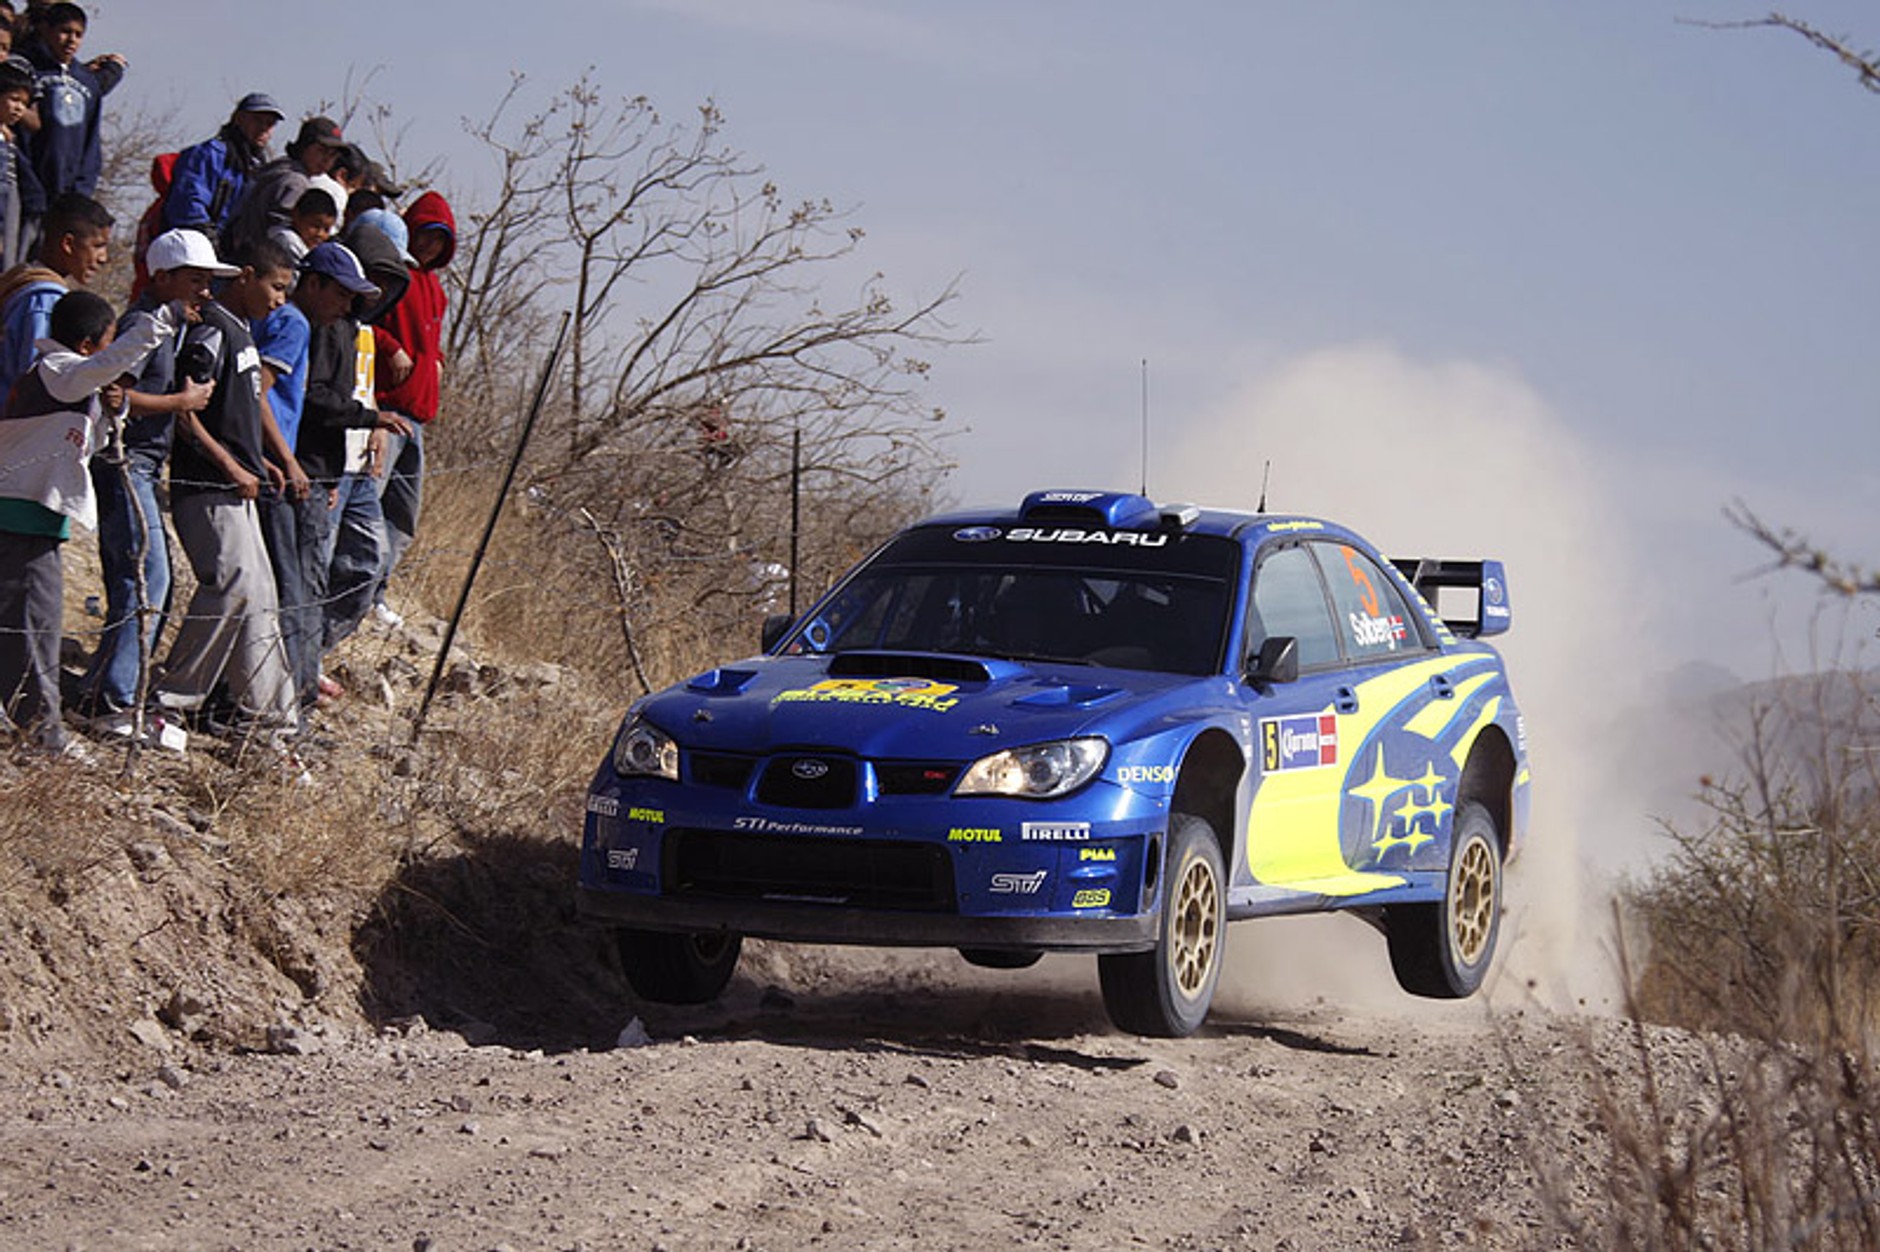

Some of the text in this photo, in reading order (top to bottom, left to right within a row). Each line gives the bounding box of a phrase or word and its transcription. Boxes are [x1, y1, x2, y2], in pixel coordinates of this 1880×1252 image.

[1005, 528, 1168, 547] SUBARU
[1340, 546, 1380, 617] 5
[1266, 723, 1278, 770] 5
[1117, 766, 1175, 783] DENSO
[628, 807, 665, 823] MOTUL
[766, 822, 864, 836] Performance
[947, 828, 1003, 842] MOTUL
[1021, 822, 1091, 840] PIRELLI
